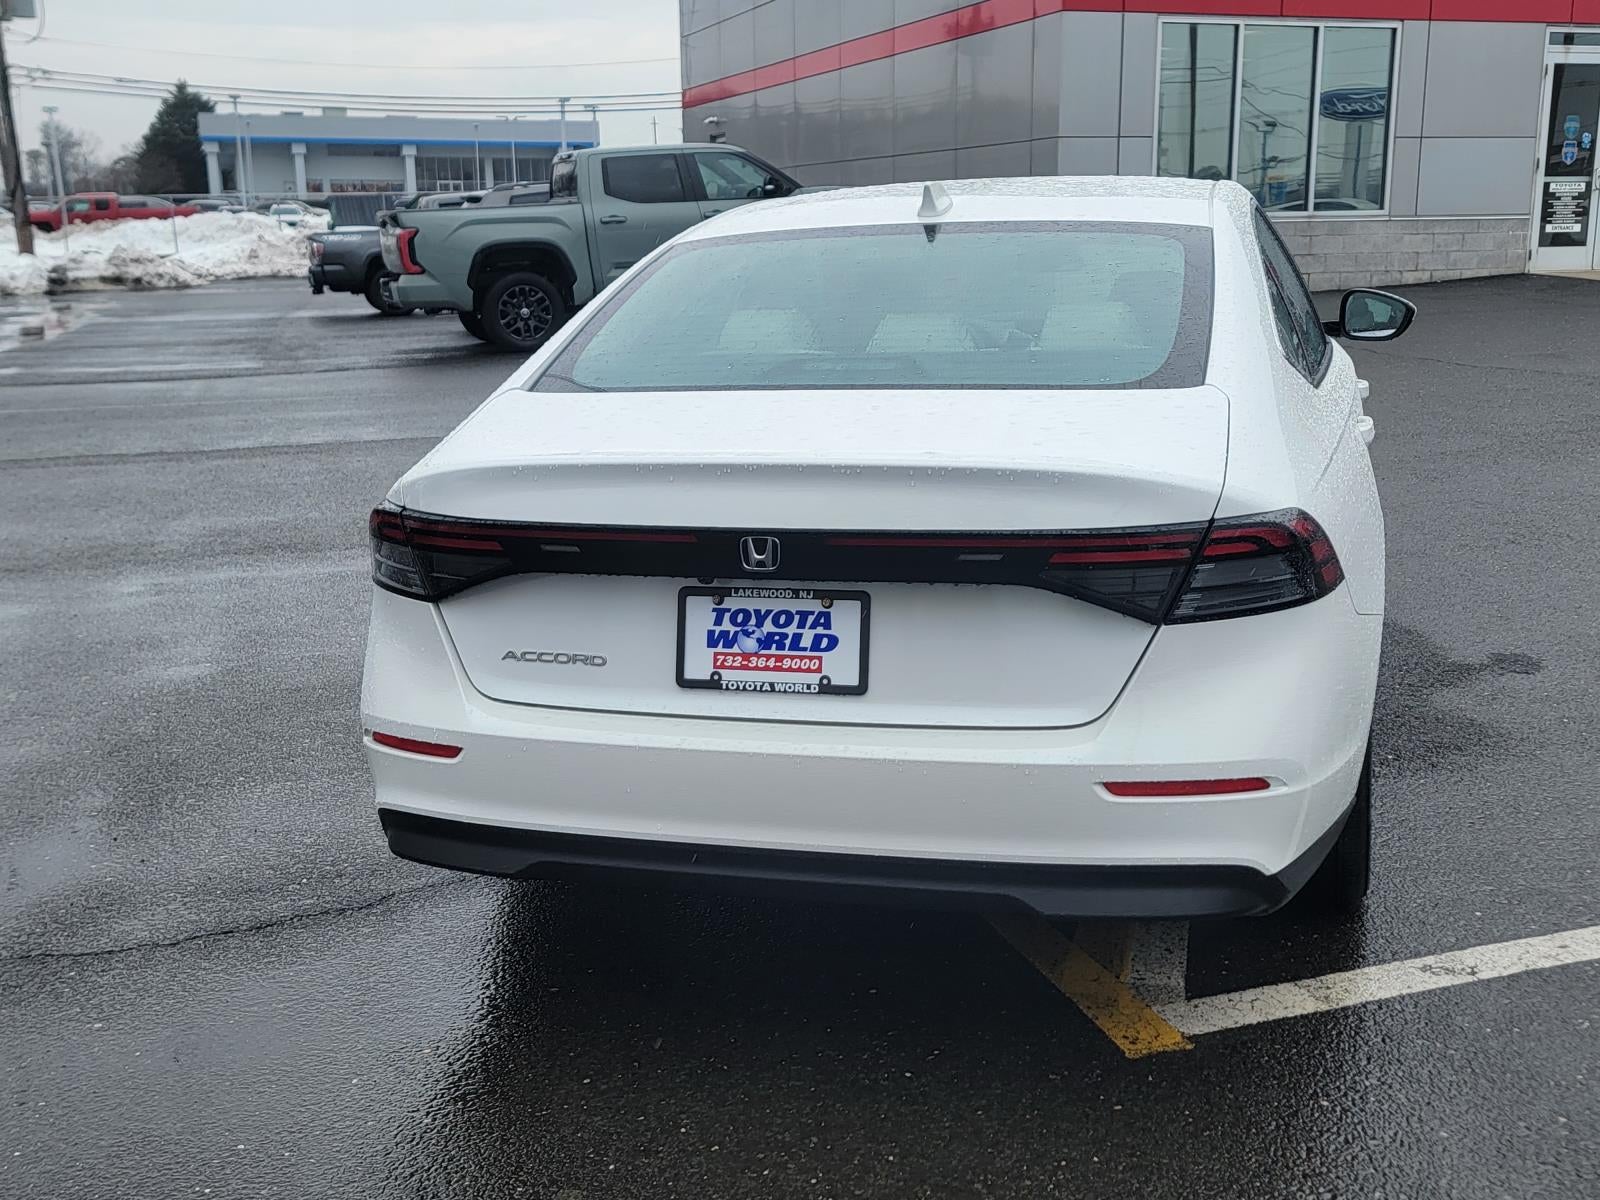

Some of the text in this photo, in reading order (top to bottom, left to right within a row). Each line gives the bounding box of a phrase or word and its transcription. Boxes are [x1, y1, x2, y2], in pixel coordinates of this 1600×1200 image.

[799, 590, 814, 599] NJ
[711, 607, 833, 631] TOYOTA
[706, 626, 839, 654] WORLD
[501, 650, 608, 667] ACCORD
[715, 655, 820, 670] 732-364-9000
[720, 680, 820, 693] TOYOTA WORLD
